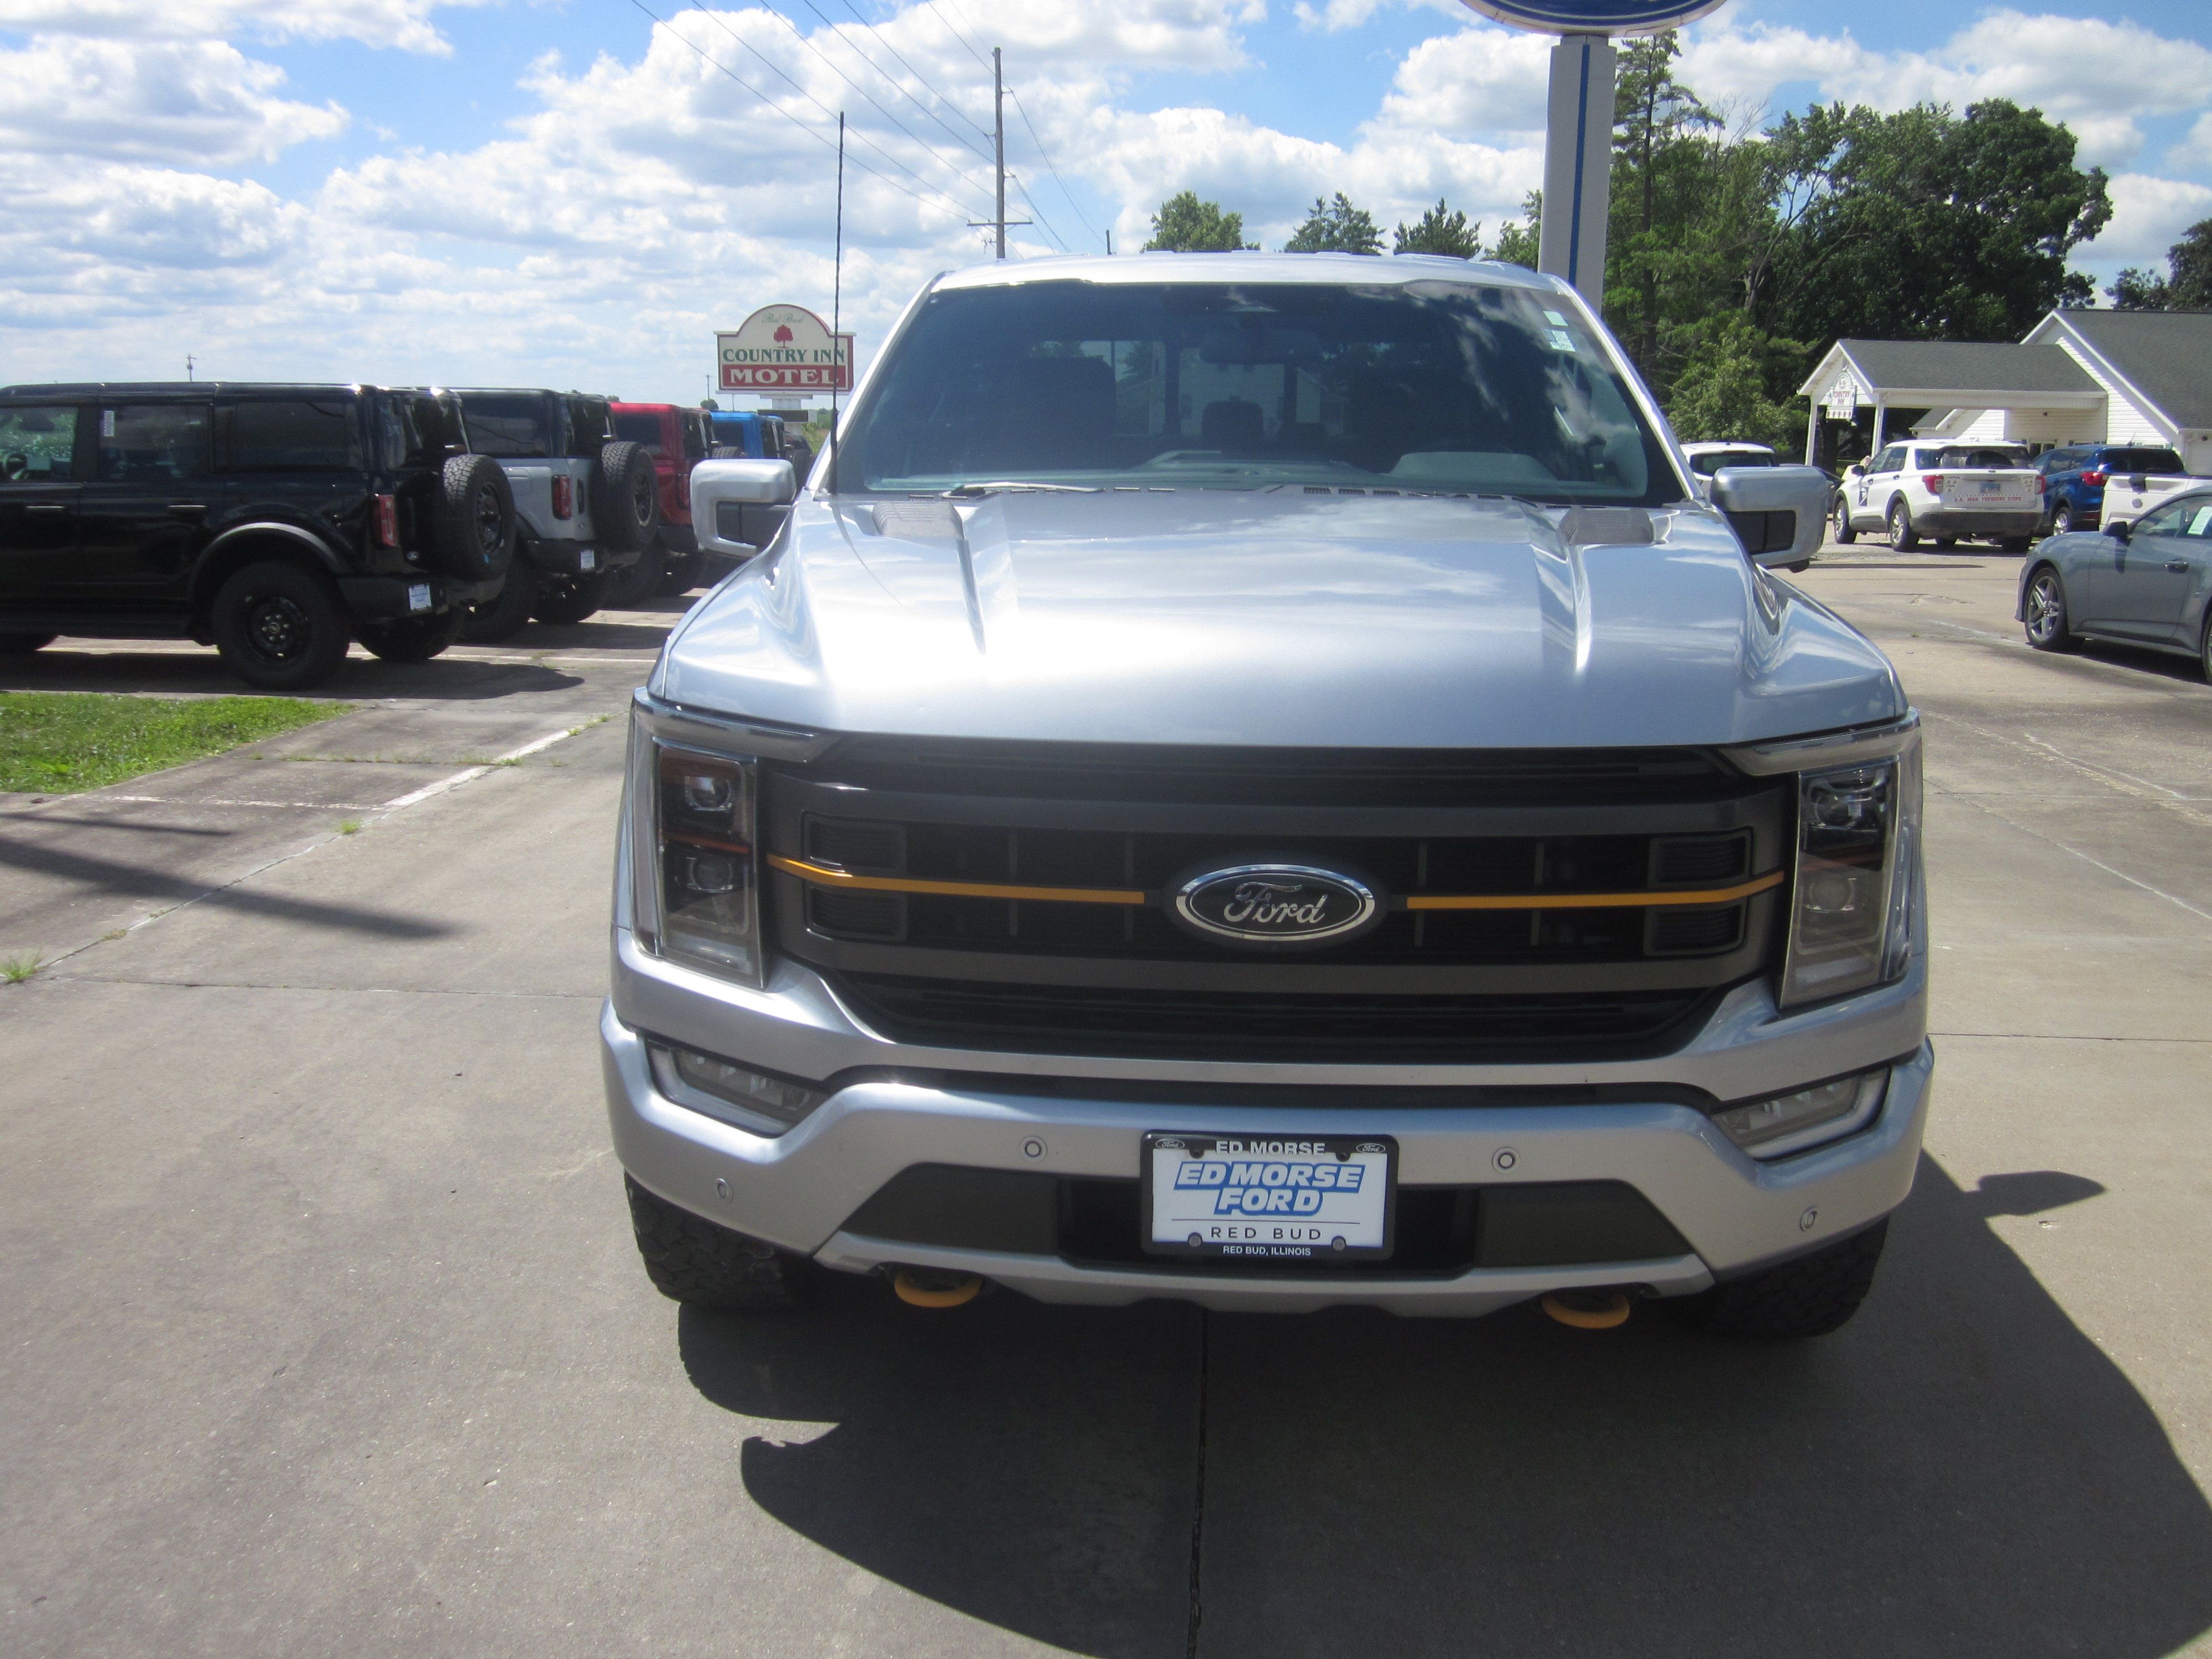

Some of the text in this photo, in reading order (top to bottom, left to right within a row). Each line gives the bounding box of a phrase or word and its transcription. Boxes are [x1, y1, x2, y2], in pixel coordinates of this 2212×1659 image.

[723, 348, 844, 363] COUNTRY INN
[730, 369, 839, 384] MOTEL
[1224, 881, 1328, 924] Ford
[1216, 1141, 1326, 1156] ED MORSE
[1175, 1162, 1365, 1193] ED MORSE
[1214, 1188, 1323, 1216] FORD
[1211, 1227, 1322, 1240] RED BUD
[1223, 1245, 1311, 1256] RED BUD, ILLINOIS
